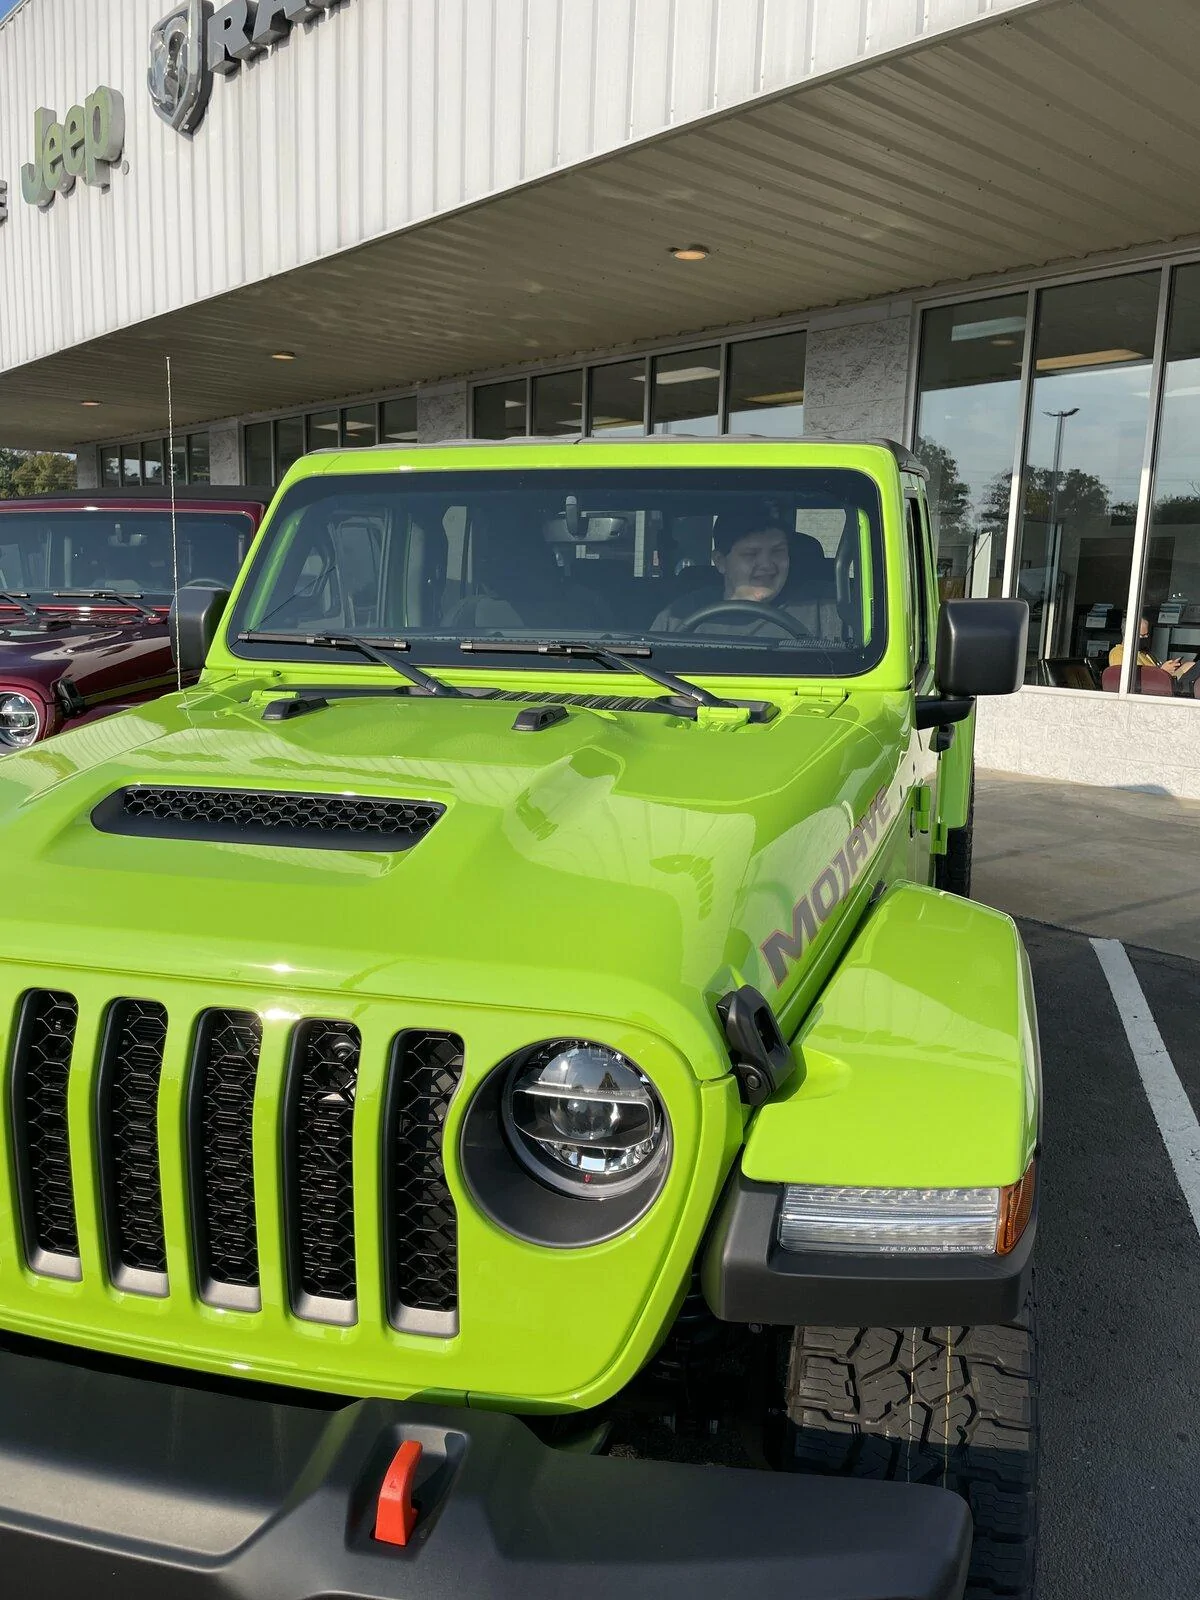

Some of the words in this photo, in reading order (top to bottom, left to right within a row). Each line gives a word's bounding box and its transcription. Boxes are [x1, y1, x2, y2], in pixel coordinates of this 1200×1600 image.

[207, 0, 350, 74] RA
[21, 85, 125, 206] Jeep
[760, 784, 892, 989] MOJAVE
